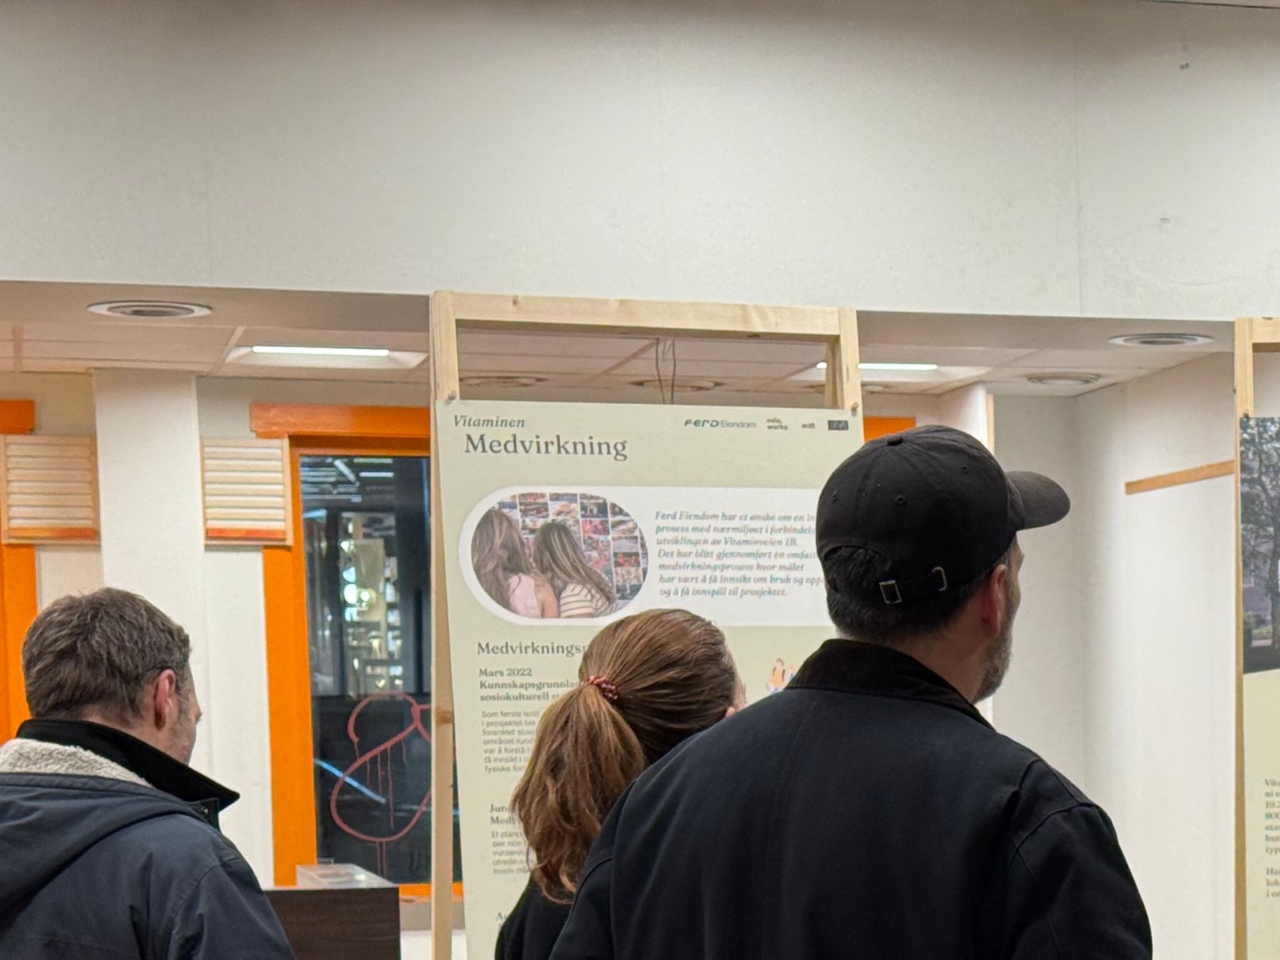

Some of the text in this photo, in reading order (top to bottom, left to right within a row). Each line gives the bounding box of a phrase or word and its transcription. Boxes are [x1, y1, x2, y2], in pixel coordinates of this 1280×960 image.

[453, 414, 525, 429] Vitaminen
[720, 420, 757, 428] Eiendom
[464, 433, 628, 462] Medvirkning
[655, 511, 677, 520] Ferd
[679, 511, 719, 520] Eiendom
[721, 512, 737, 521] har
[655, 525, 689, 535] prosess
[691, 524, 711, 533] med
[656, 537, 709, 547] utviklingen
[658, 549, 674, 558] Det
[676, 549, 693, 558] har
[694, 549, 714, 558] blitt
[756, 562, 777, 571] hvor
[778, 562, 805, 571] målet
[659, 574, 676, 583] har
[719, 574, 751, 584] innsikt
[769, 574, 792, 584] bruk
[793, 577, 804, 587] og
[660, 588, 672, 598] og
[691, 587, 727, 598] innspill
[728, 587, 739, 596] til
[479, 668, 533, 677] Mars 2022
[480, 680, 578, 691] Kunnskapsgrunnla
